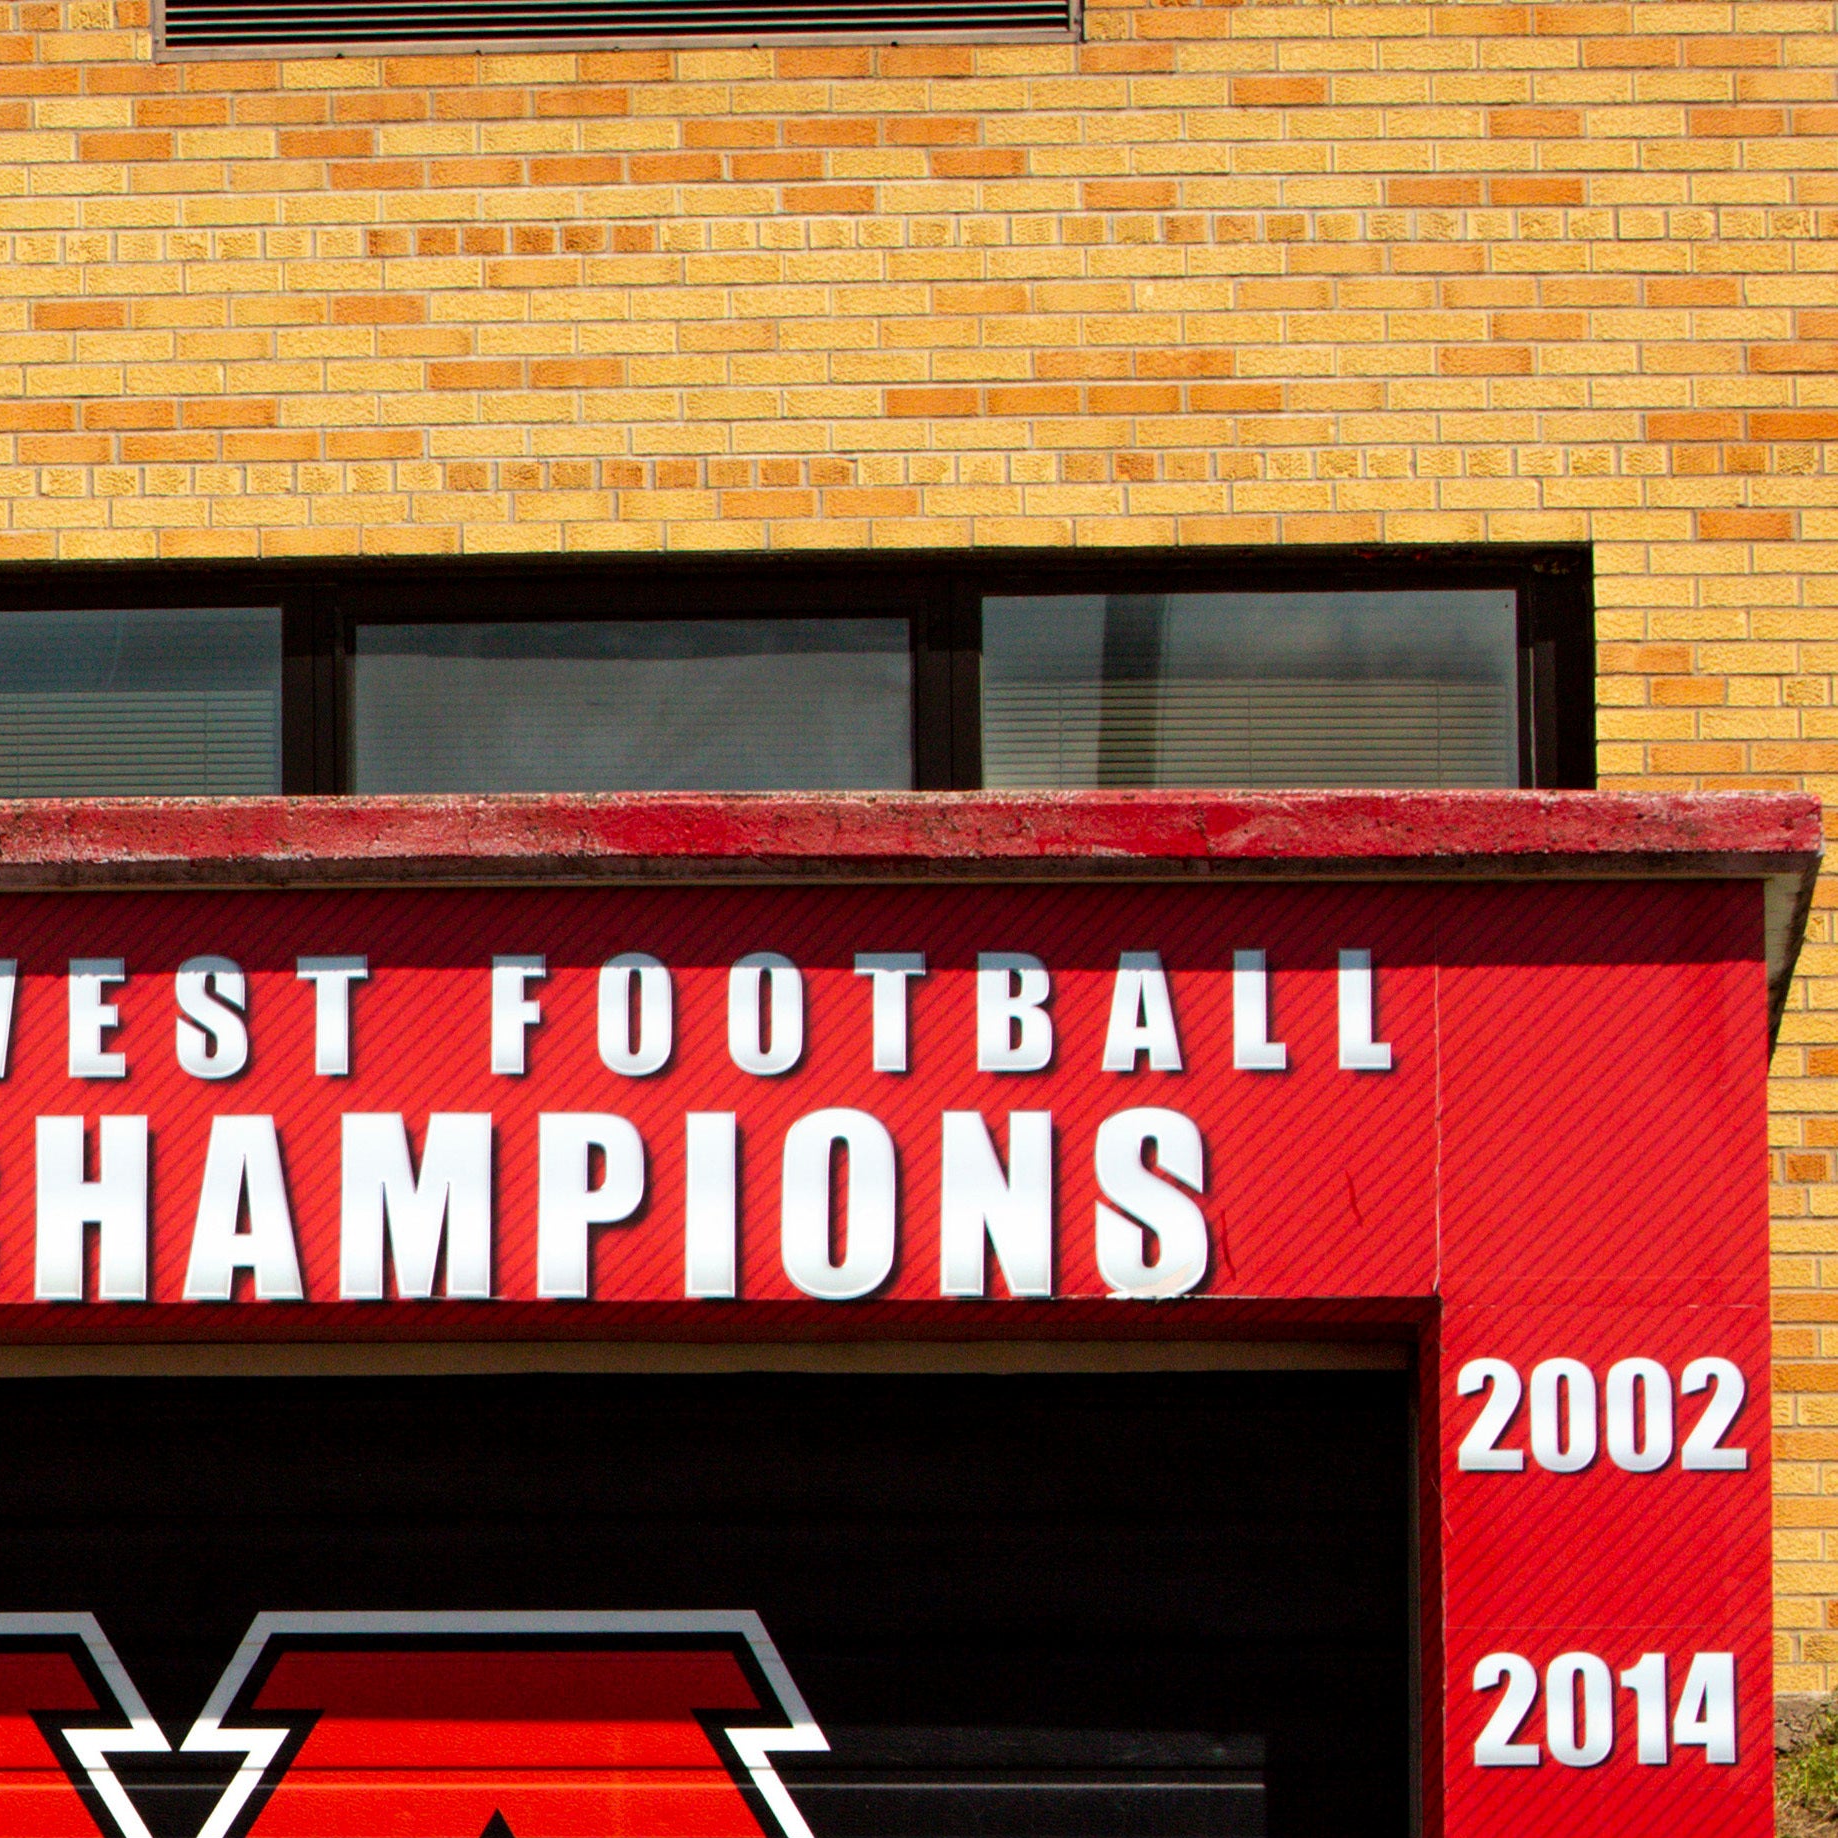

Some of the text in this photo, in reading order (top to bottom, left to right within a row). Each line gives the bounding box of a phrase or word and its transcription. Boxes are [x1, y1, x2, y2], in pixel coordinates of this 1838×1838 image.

[491, 951, 1392, 1077] FOOTBALL
[1457, 1356, 1748, 1473] 2002
[1473, 1651, 1737, 1767] 2014
